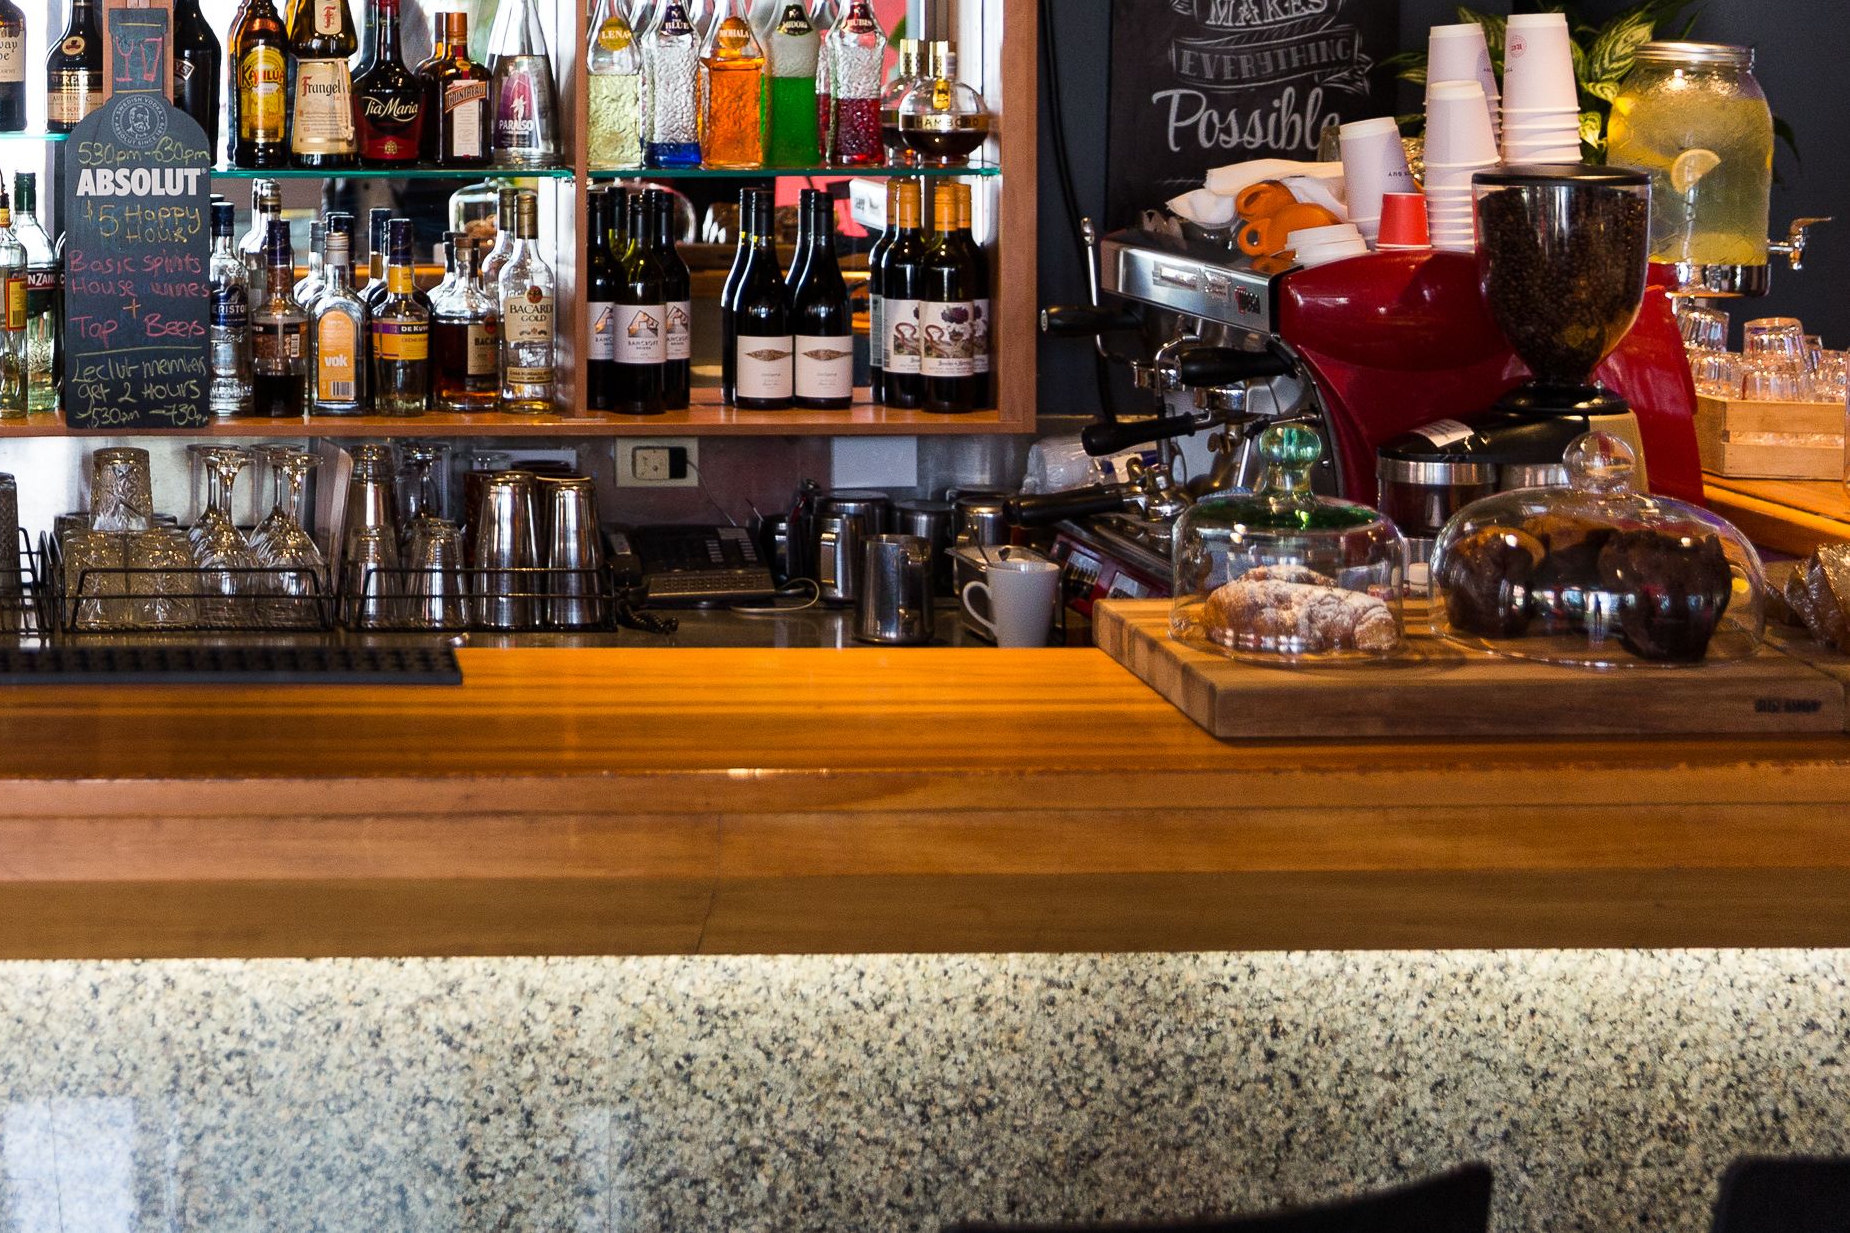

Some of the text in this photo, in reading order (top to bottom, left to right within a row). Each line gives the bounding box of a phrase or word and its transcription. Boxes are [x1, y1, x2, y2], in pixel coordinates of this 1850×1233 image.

[664, 21, 690, 30] BLUE
[1179, 37, 1352, 79] EVERYTHING
[381, 97, 419, 119] Maria
[76, 168, 201, 197] ABSOLUT
[72, 277, 138, 297] House
[325, 353, 348, 366] vok
[117, 381, 138, 403] 2
